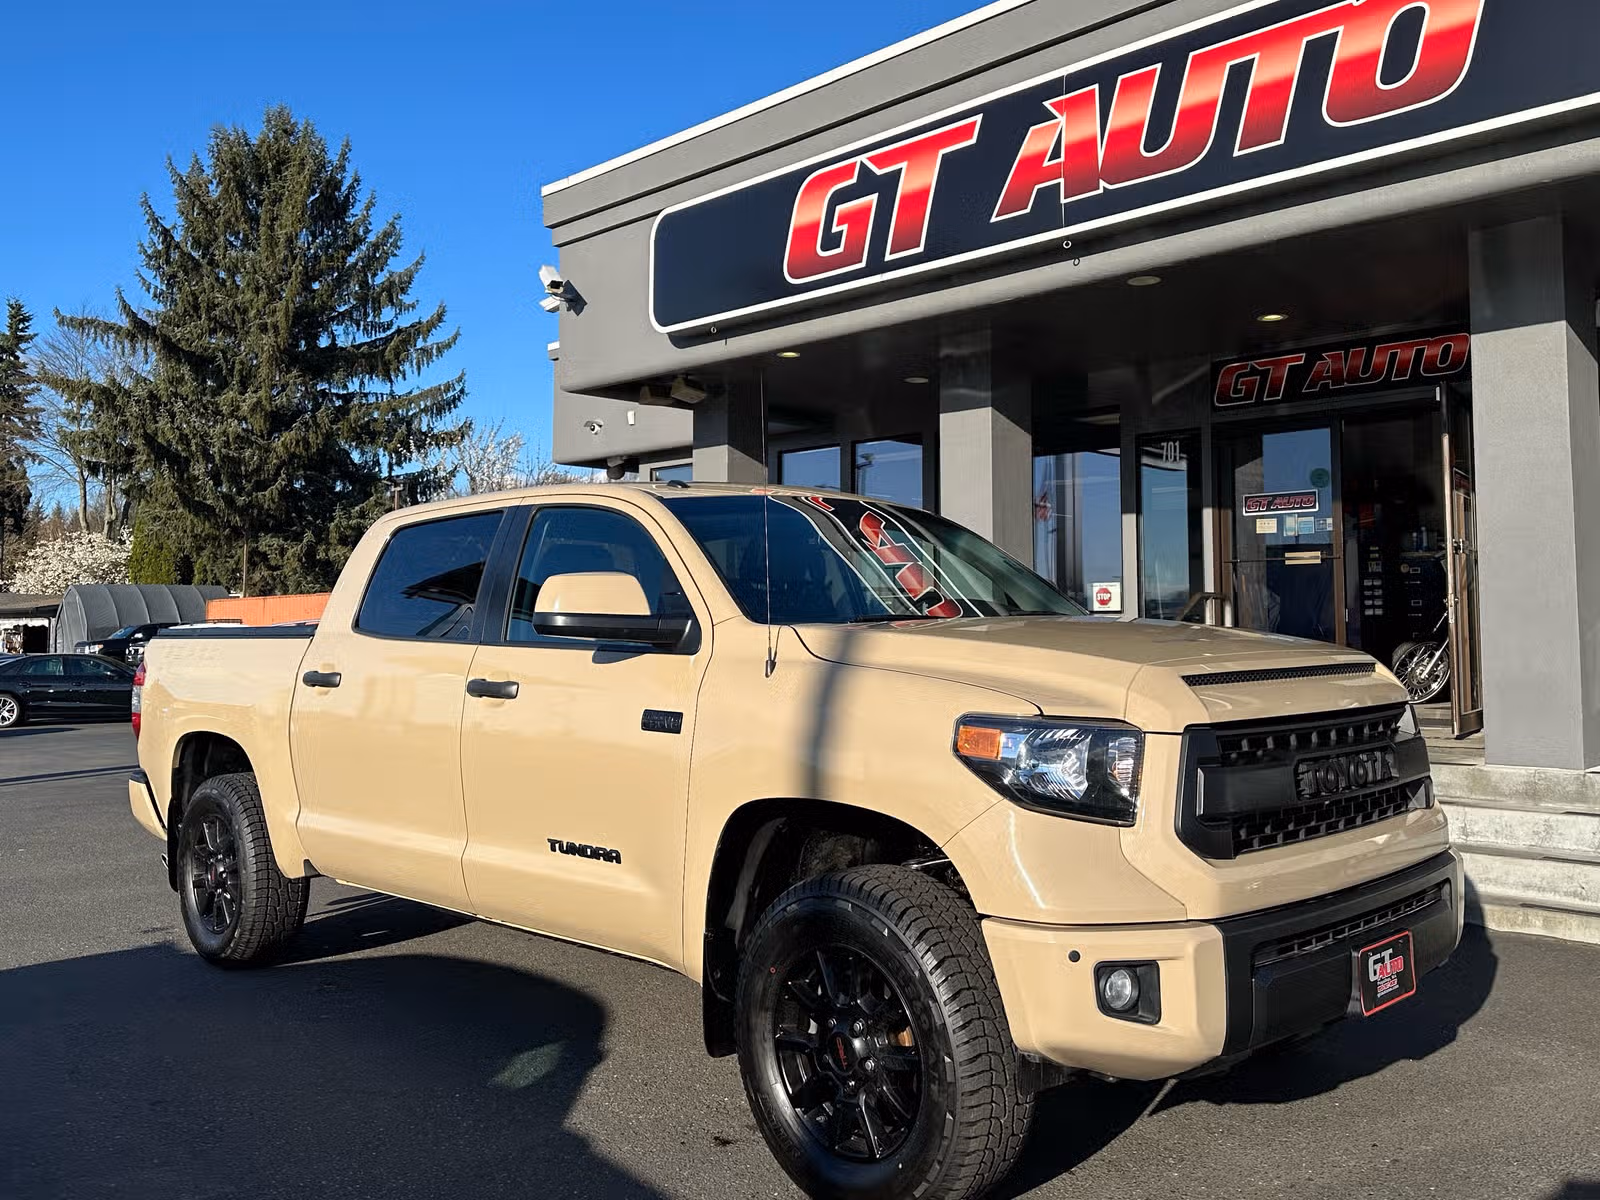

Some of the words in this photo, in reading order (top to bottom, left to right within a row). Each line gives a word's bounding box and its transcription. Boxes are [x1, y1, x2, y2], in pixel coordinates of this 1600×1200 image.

[783, 113, 983, 285] GT
[990, 0, 1485, 223] AUTO
[1214, 353, 1306, 407] GT
[1302, 333, 1470, 392] AUTO
[1160, 440, 1180, 462] 701
[1245, 496, 1273, 512] GT
[1270, 494, 1316, 510] AUTO
[1096, 592, 1112, 601] STOP
[1302, 751, 1394, 795] TOYOTA
[547, 838, 622, 864] TUNDRA
[1368, 947, 1393, 982] GT
